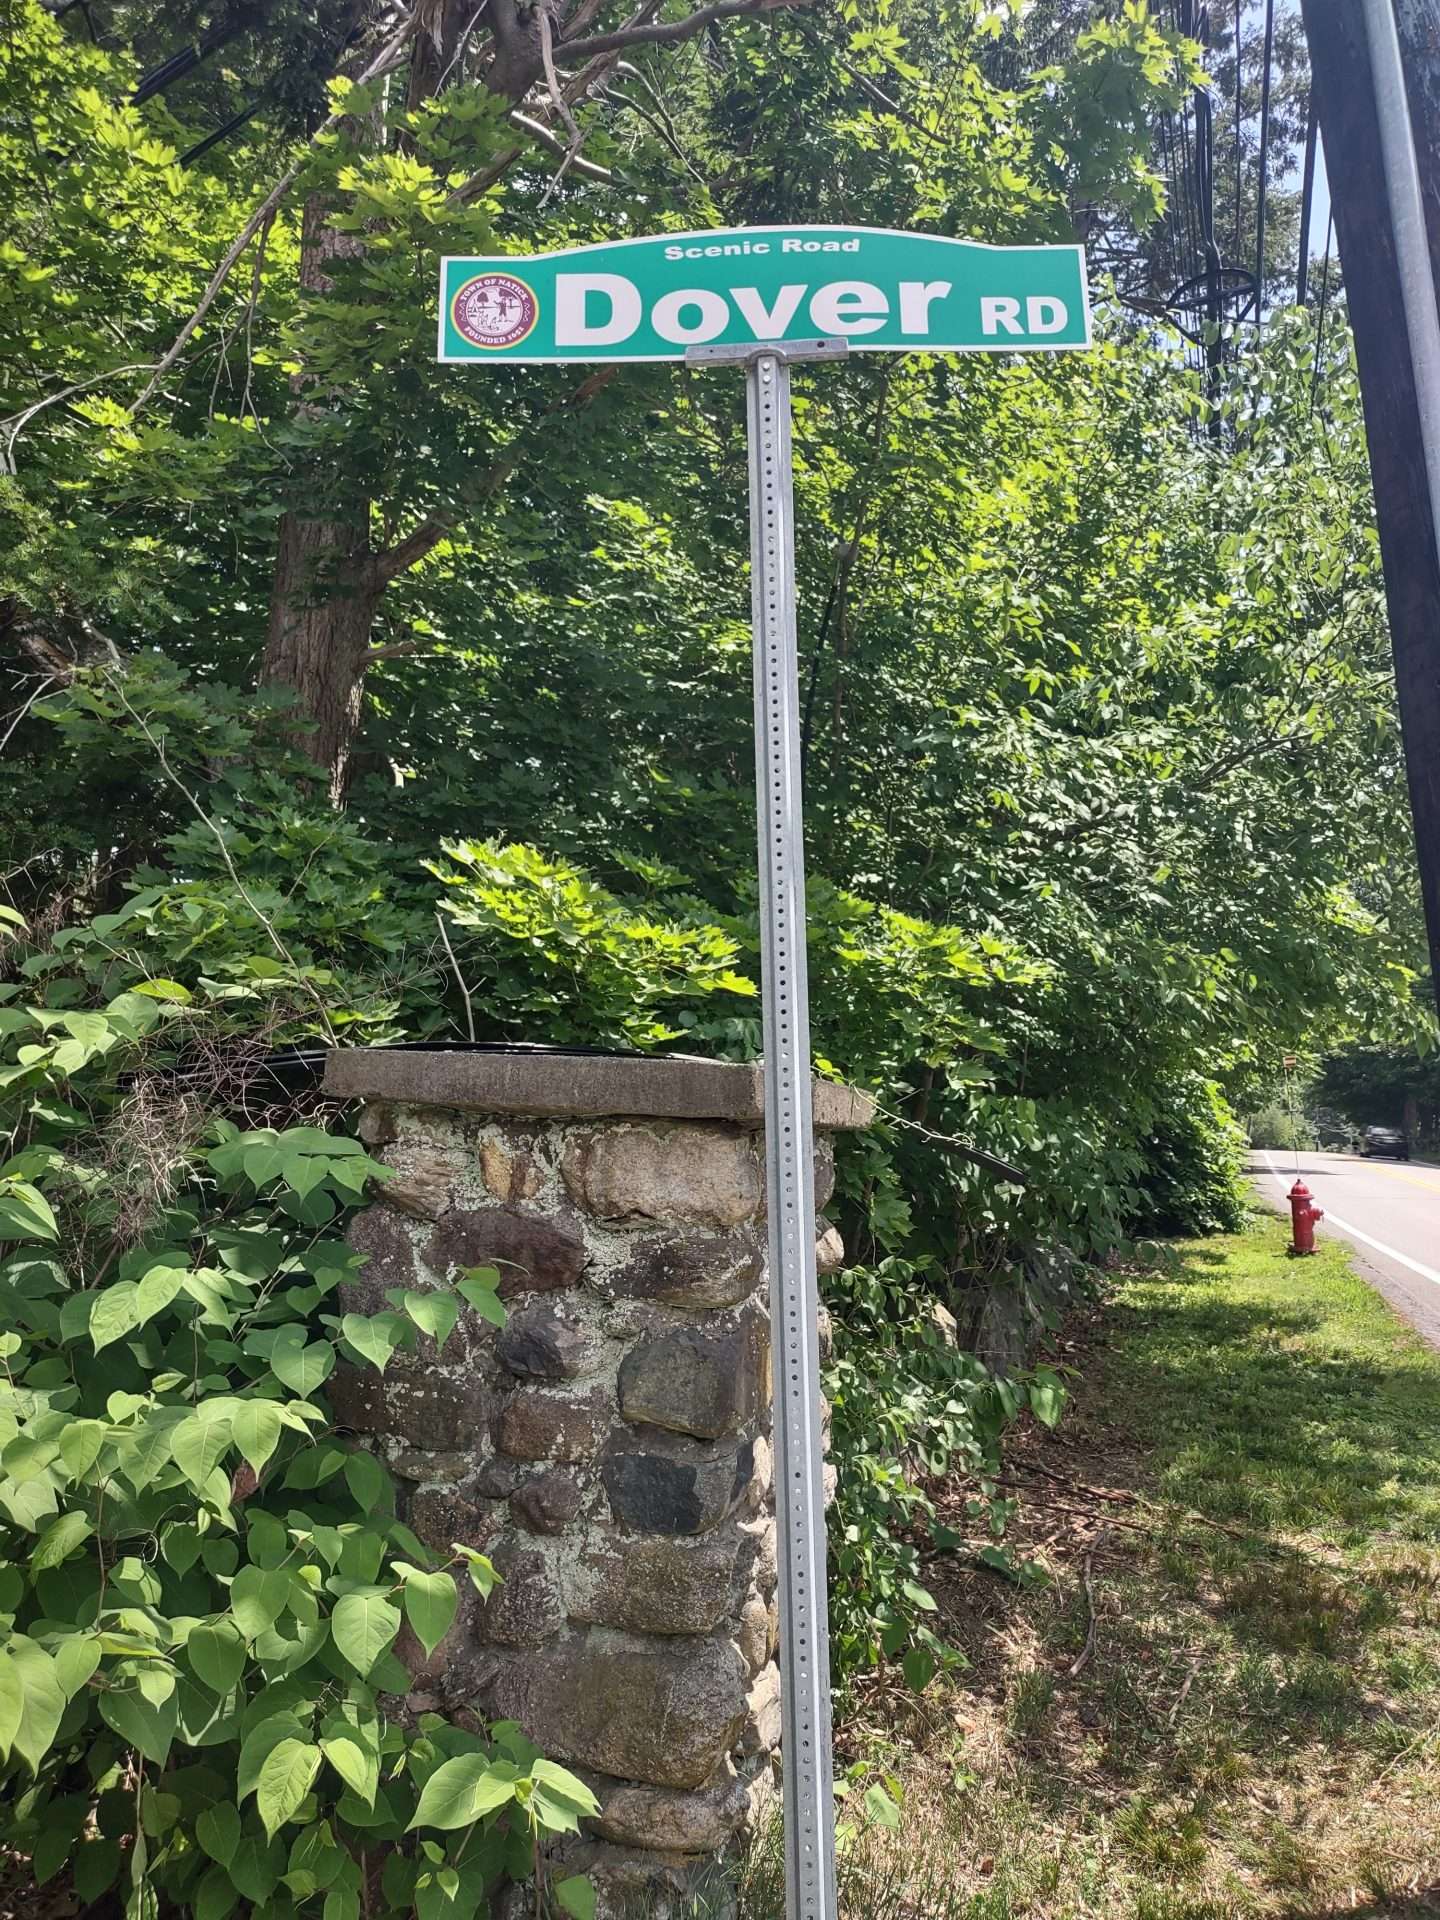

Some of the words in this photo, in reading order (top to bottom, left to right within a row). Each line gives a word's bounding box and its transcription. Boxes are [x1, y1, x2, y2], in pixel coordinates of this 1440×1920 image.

[664, 240, 771, 261] Scenic
[782, 237, 861, 253] Road
[460, 281, 483, 301] TOWN
[484, 278, 496, 286] OF
[498, 279, 528, 301] NATICK
[555, 273, 952, 346] Dover
[980, 296, 1069, 335] RD
[464, 326, 506, 344] FOUNDED
[508, 326, 525, 341] 1651
